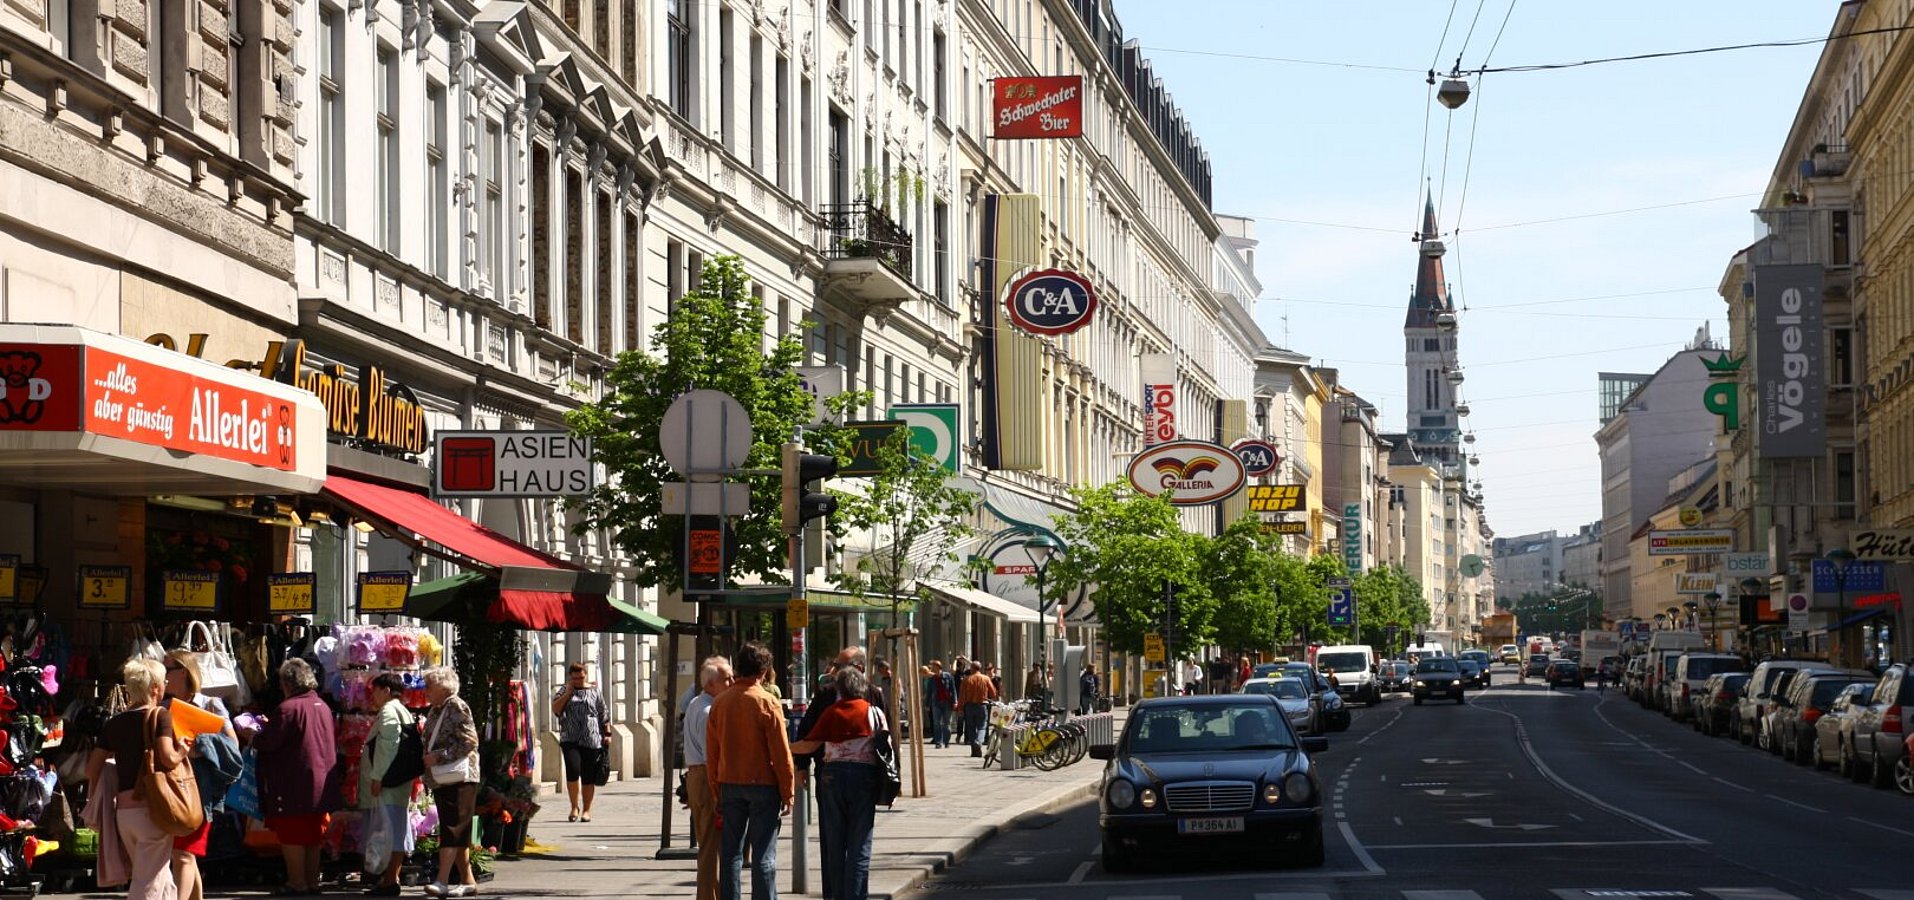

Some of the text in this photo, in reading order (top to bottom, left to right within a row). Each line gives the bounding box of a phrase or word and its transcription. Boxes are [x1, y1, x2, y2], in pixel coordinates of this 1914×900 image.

[999, 86, 1076, 127] Schwechater
[1040, 112, 1069, 131] Bier
[1024, 287, 1079, 315] C&A
[1777, 288, 1808, 433] Vögele
[94, 391, 173, 440] aber günstig
[367, 365, 423, 453] Blumen
[1145, 383, 1154, 444] INTERSPORT
[1153, 384, 1175, 441] eybl
[1766, 380, 1776, 434] Charles
[501, 437, 586, 458] ASIEN
[1239, 450, 1269, 466] C&A
[501, 470, 586, 492] HAUS
